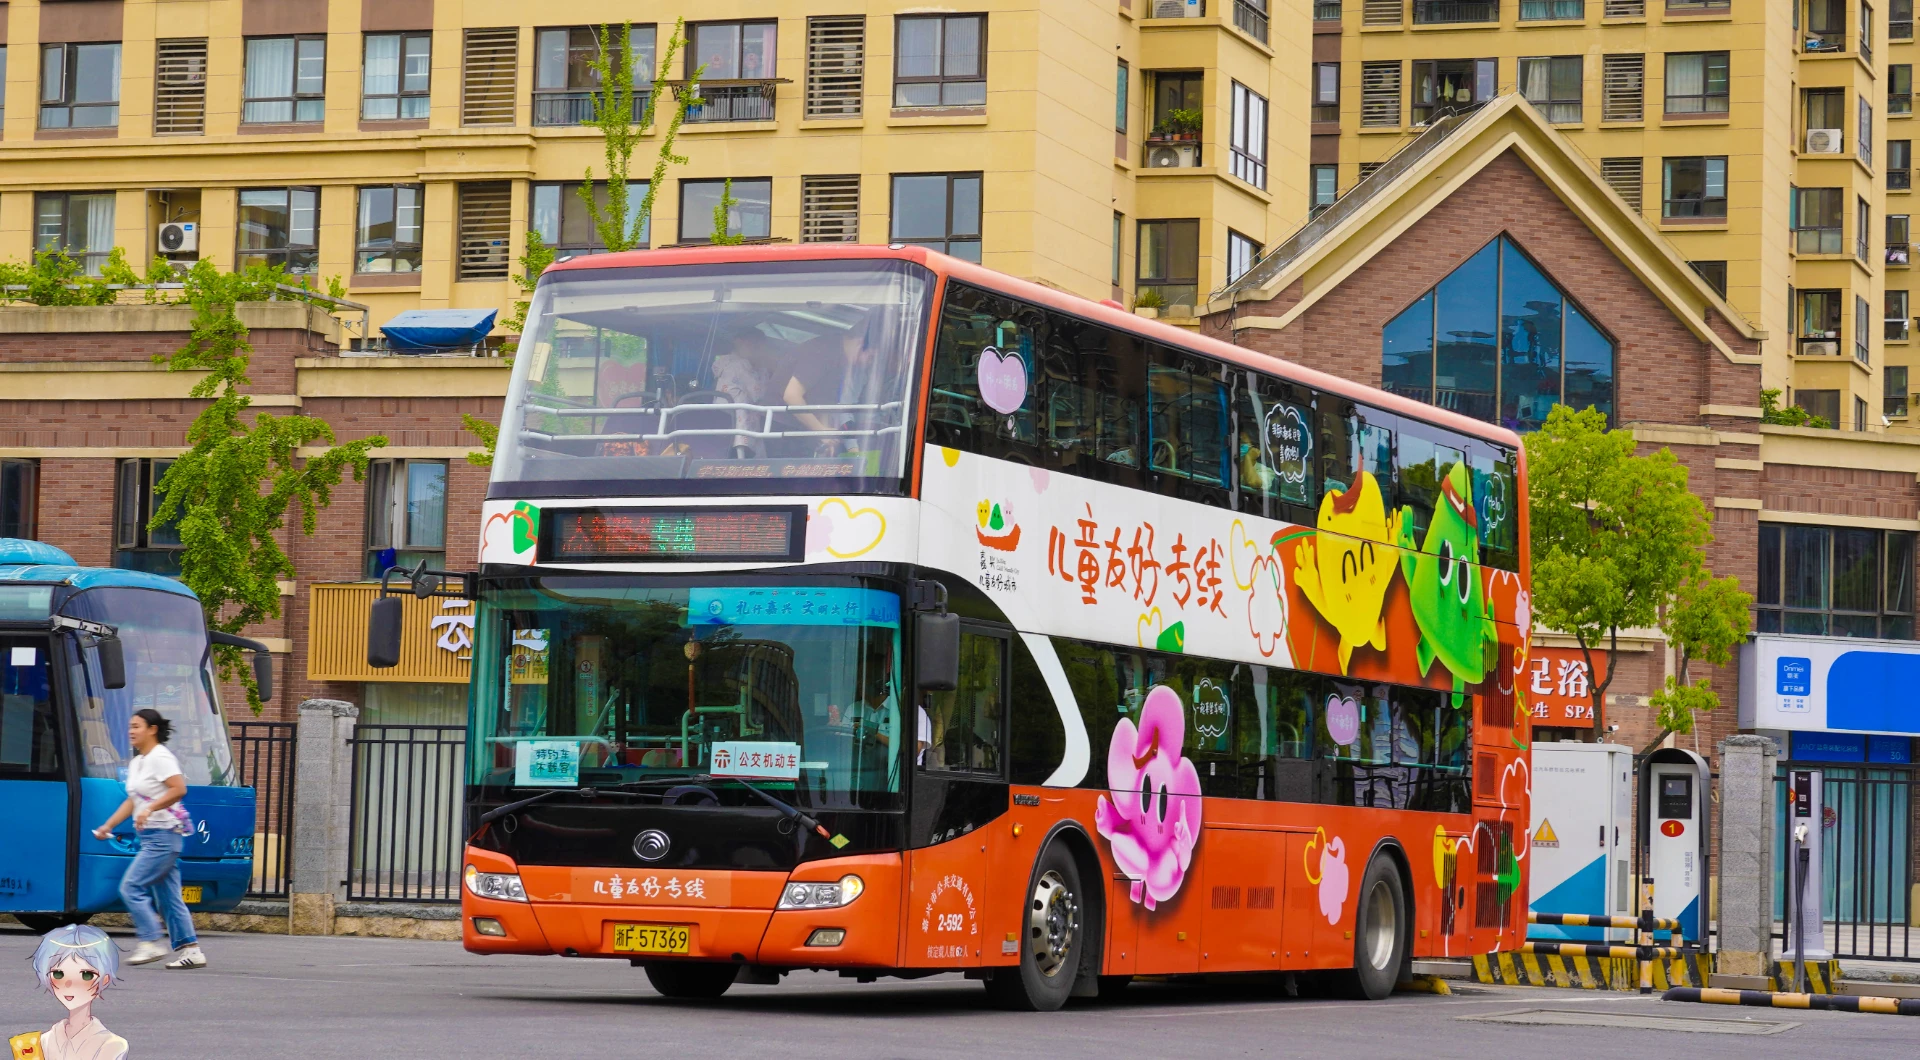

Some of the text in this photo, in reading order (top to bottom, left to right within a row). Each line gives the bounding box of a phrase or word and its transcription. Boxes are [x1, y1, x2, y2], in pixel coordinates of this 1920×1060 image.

[1048, 502, 1228, 619] 儿童友好专线
[802, 600, 860, 615] 文明出行
[1565, 705, 1595, 719] SPA
[739, 752, 797, 769] 公交机动车
[1669, 823, 1675, 834] 1
[593, 874, 707, 899] 儿童友好专线
[938, 914, 963, 931] 2-592
